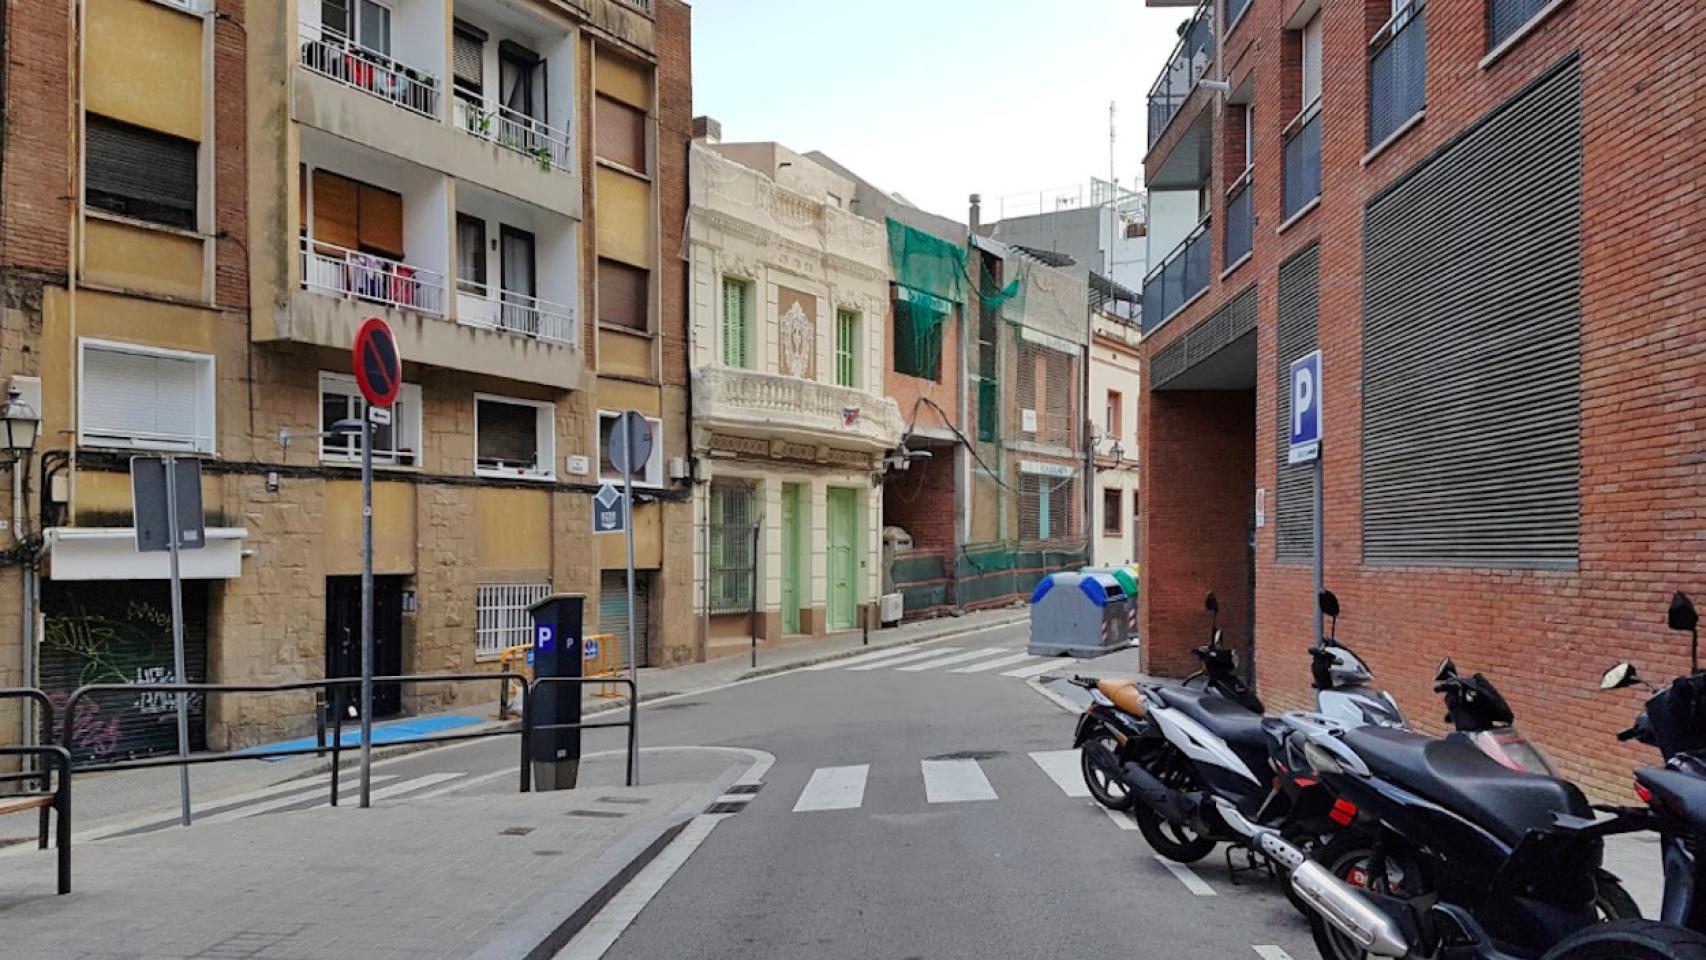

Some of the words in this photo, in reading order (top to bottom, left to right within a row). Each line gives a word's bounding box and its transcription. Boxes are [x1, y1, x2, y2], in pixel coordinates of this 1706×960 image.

[1295, 367, 1314, 436] P
[538, 627, 552, 648] P
[566, 637, 574, 649] P
